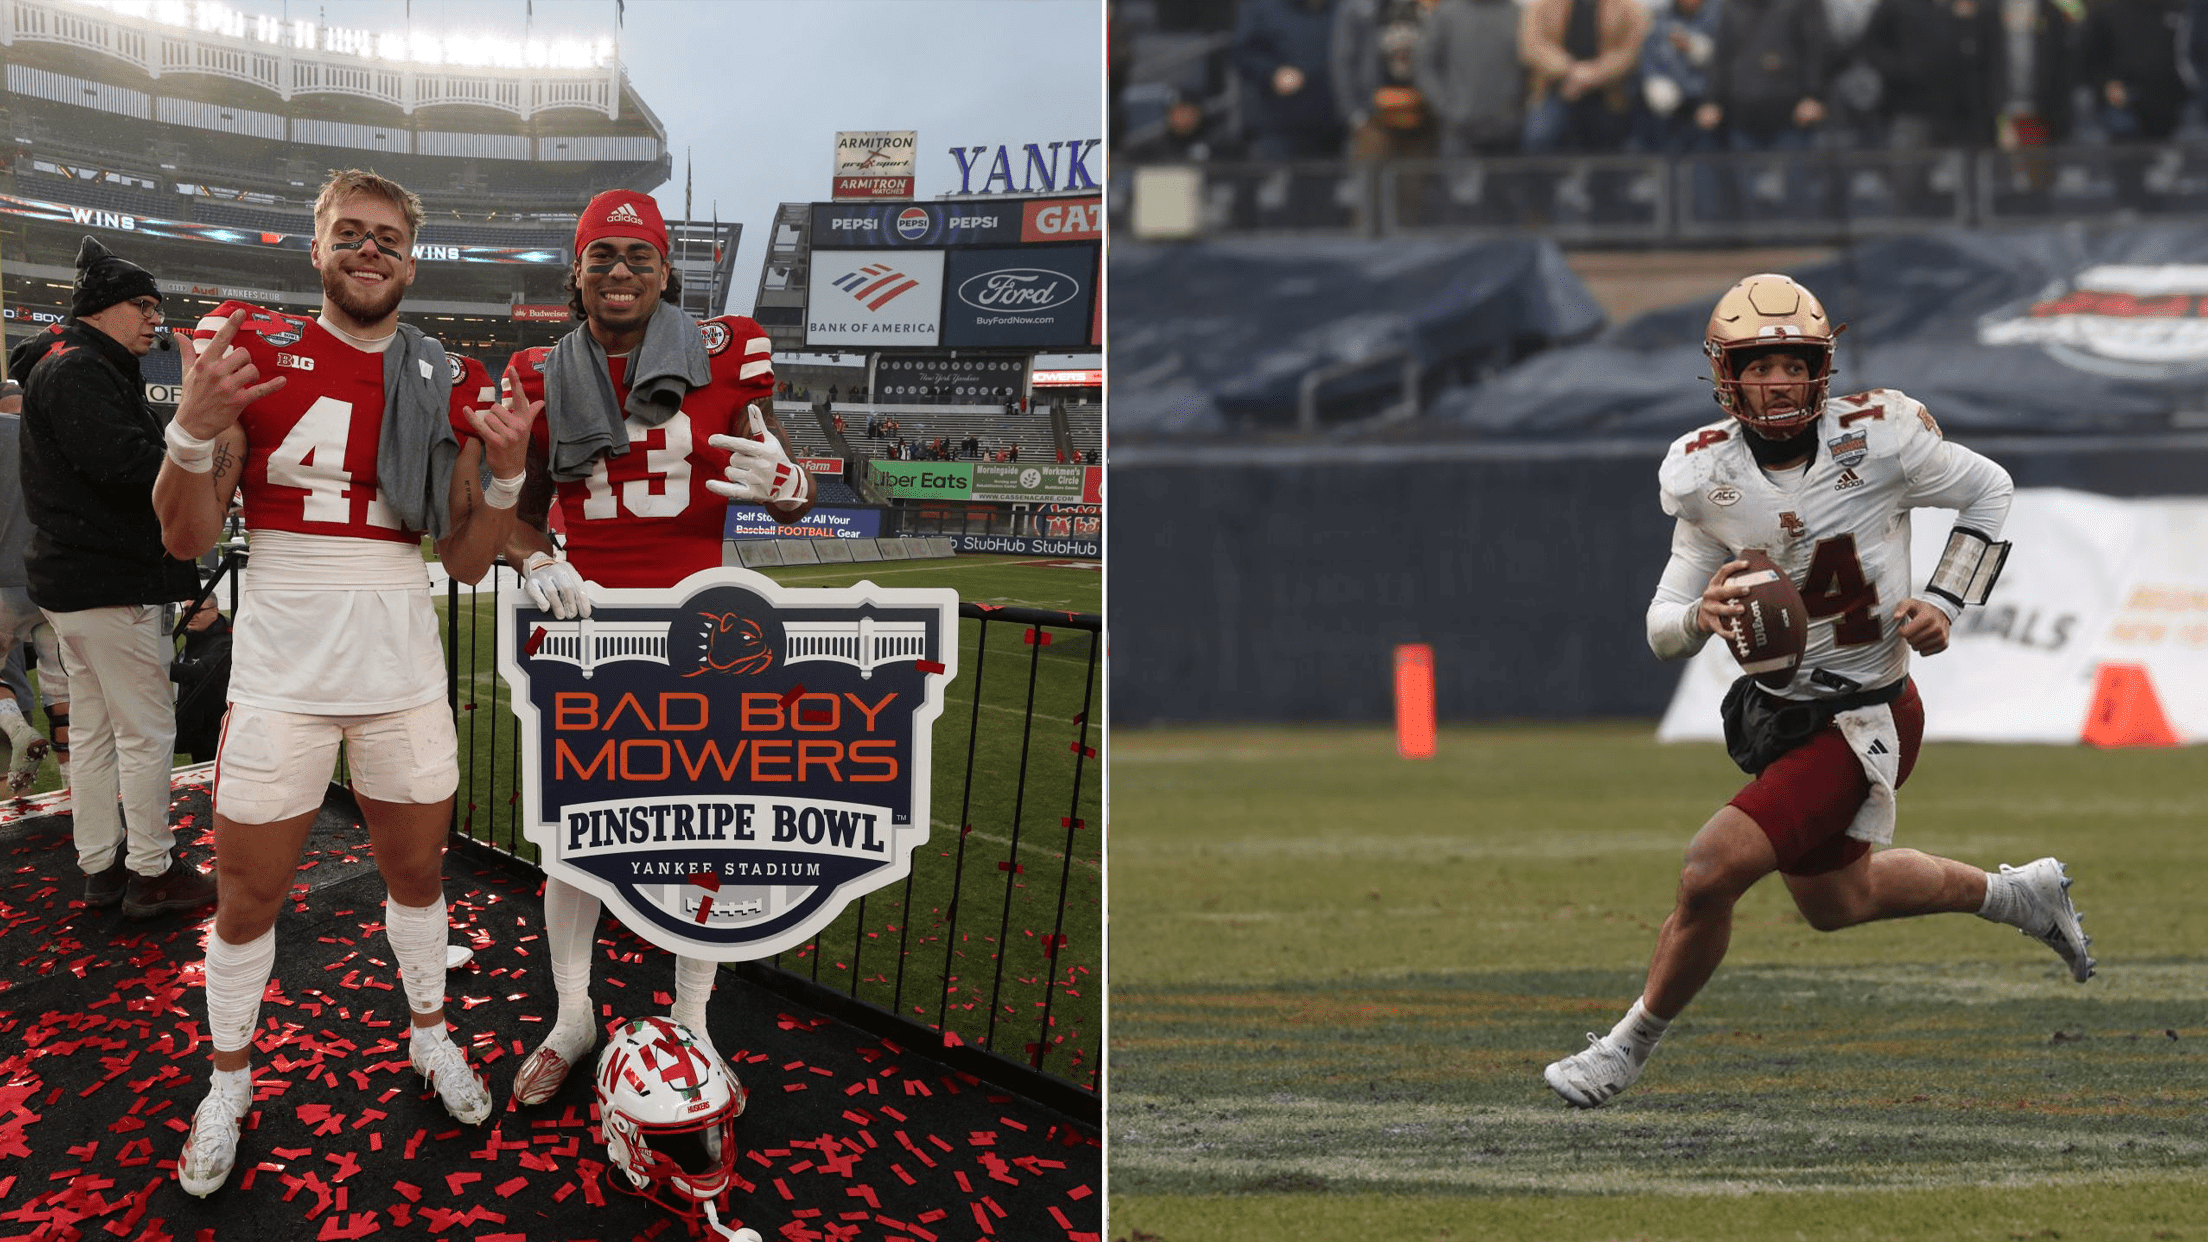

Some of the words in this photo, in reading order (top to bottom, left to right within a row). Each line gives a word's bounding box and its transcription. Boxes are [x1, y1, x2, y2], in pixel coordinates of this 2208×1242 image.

[838, 137, 914, 149] ARMITRON
[876, 160, 909, 168] sport
[948, 138, 1102, 196] YANK
[840, 179, 907, 189] ARMITRON
[70, 207, 136, 230] WINS
[606, 212, 644, 226] adidas
[832, 218, 879, 231] PEPSI
[899, 218, 928, 228] PEPSI
[949, 216, 999, 229] PEPSI
[191, 284, 219, 296] Audi
[222, 287, 258, 299] YANKEES
[260, 291, 281, 301] CLUB
[978, 274, 1058, 305] Ford
[33, 312, 65, 324] BOY
[529, 308, 569, 318] Budweiser
[976, 316, 1055, 325] BuyFordNow.com
[810, 322, 847, 333] BANK
[851, 322, 869, 333] OF
[872, 322, 936, 333] AMERICA
[934, 373, 951, 385] York
[583, 410, 694, 520] 13
[977, 465, 1019, 476] Morningside
[1042, 467, 1081, 476] Workmen's
[875, 471, 917, 488] Uber
[921, 472, 968, 490] Eats
[1058, 476, 1080, 485] Circle
[1834, 479, 1866, 491] adidas
[978, 493, 1075, 502] WWW.CASSENACARE.COM
[1714, 492, 1737, 501] ACC
[736, 512, 756, 522] Self
[757, 513, 776, 523] Sto
[813, 515, 827, 525] All
[828, 515, 851, 525] Your
[736, 525, 776, 536] Baseball
[778, 526, 835, 537] FOOTBALL
[837, 529, 861, 539] Gear
[963, 537, 1026, 552] StubHub
[1032, 540, 1098, 555] StubHub
[1751, 600, 1769, 648] Wilson
[555, 692, 710, 732] BAD
[741, 691, 899, 732] BOY
[555, 739, 899, 782] MOWERS
[567, 803, 755, 851] PINSTRIPE
[772, 804, 885, 853] BOWL
[631, 861, 713, 876] YANKEE
[725, 862, 821, 877] STADIUM
[602, 1046, 630, 1095] N
[687, 1100, 711, 1114] HUSKERS
